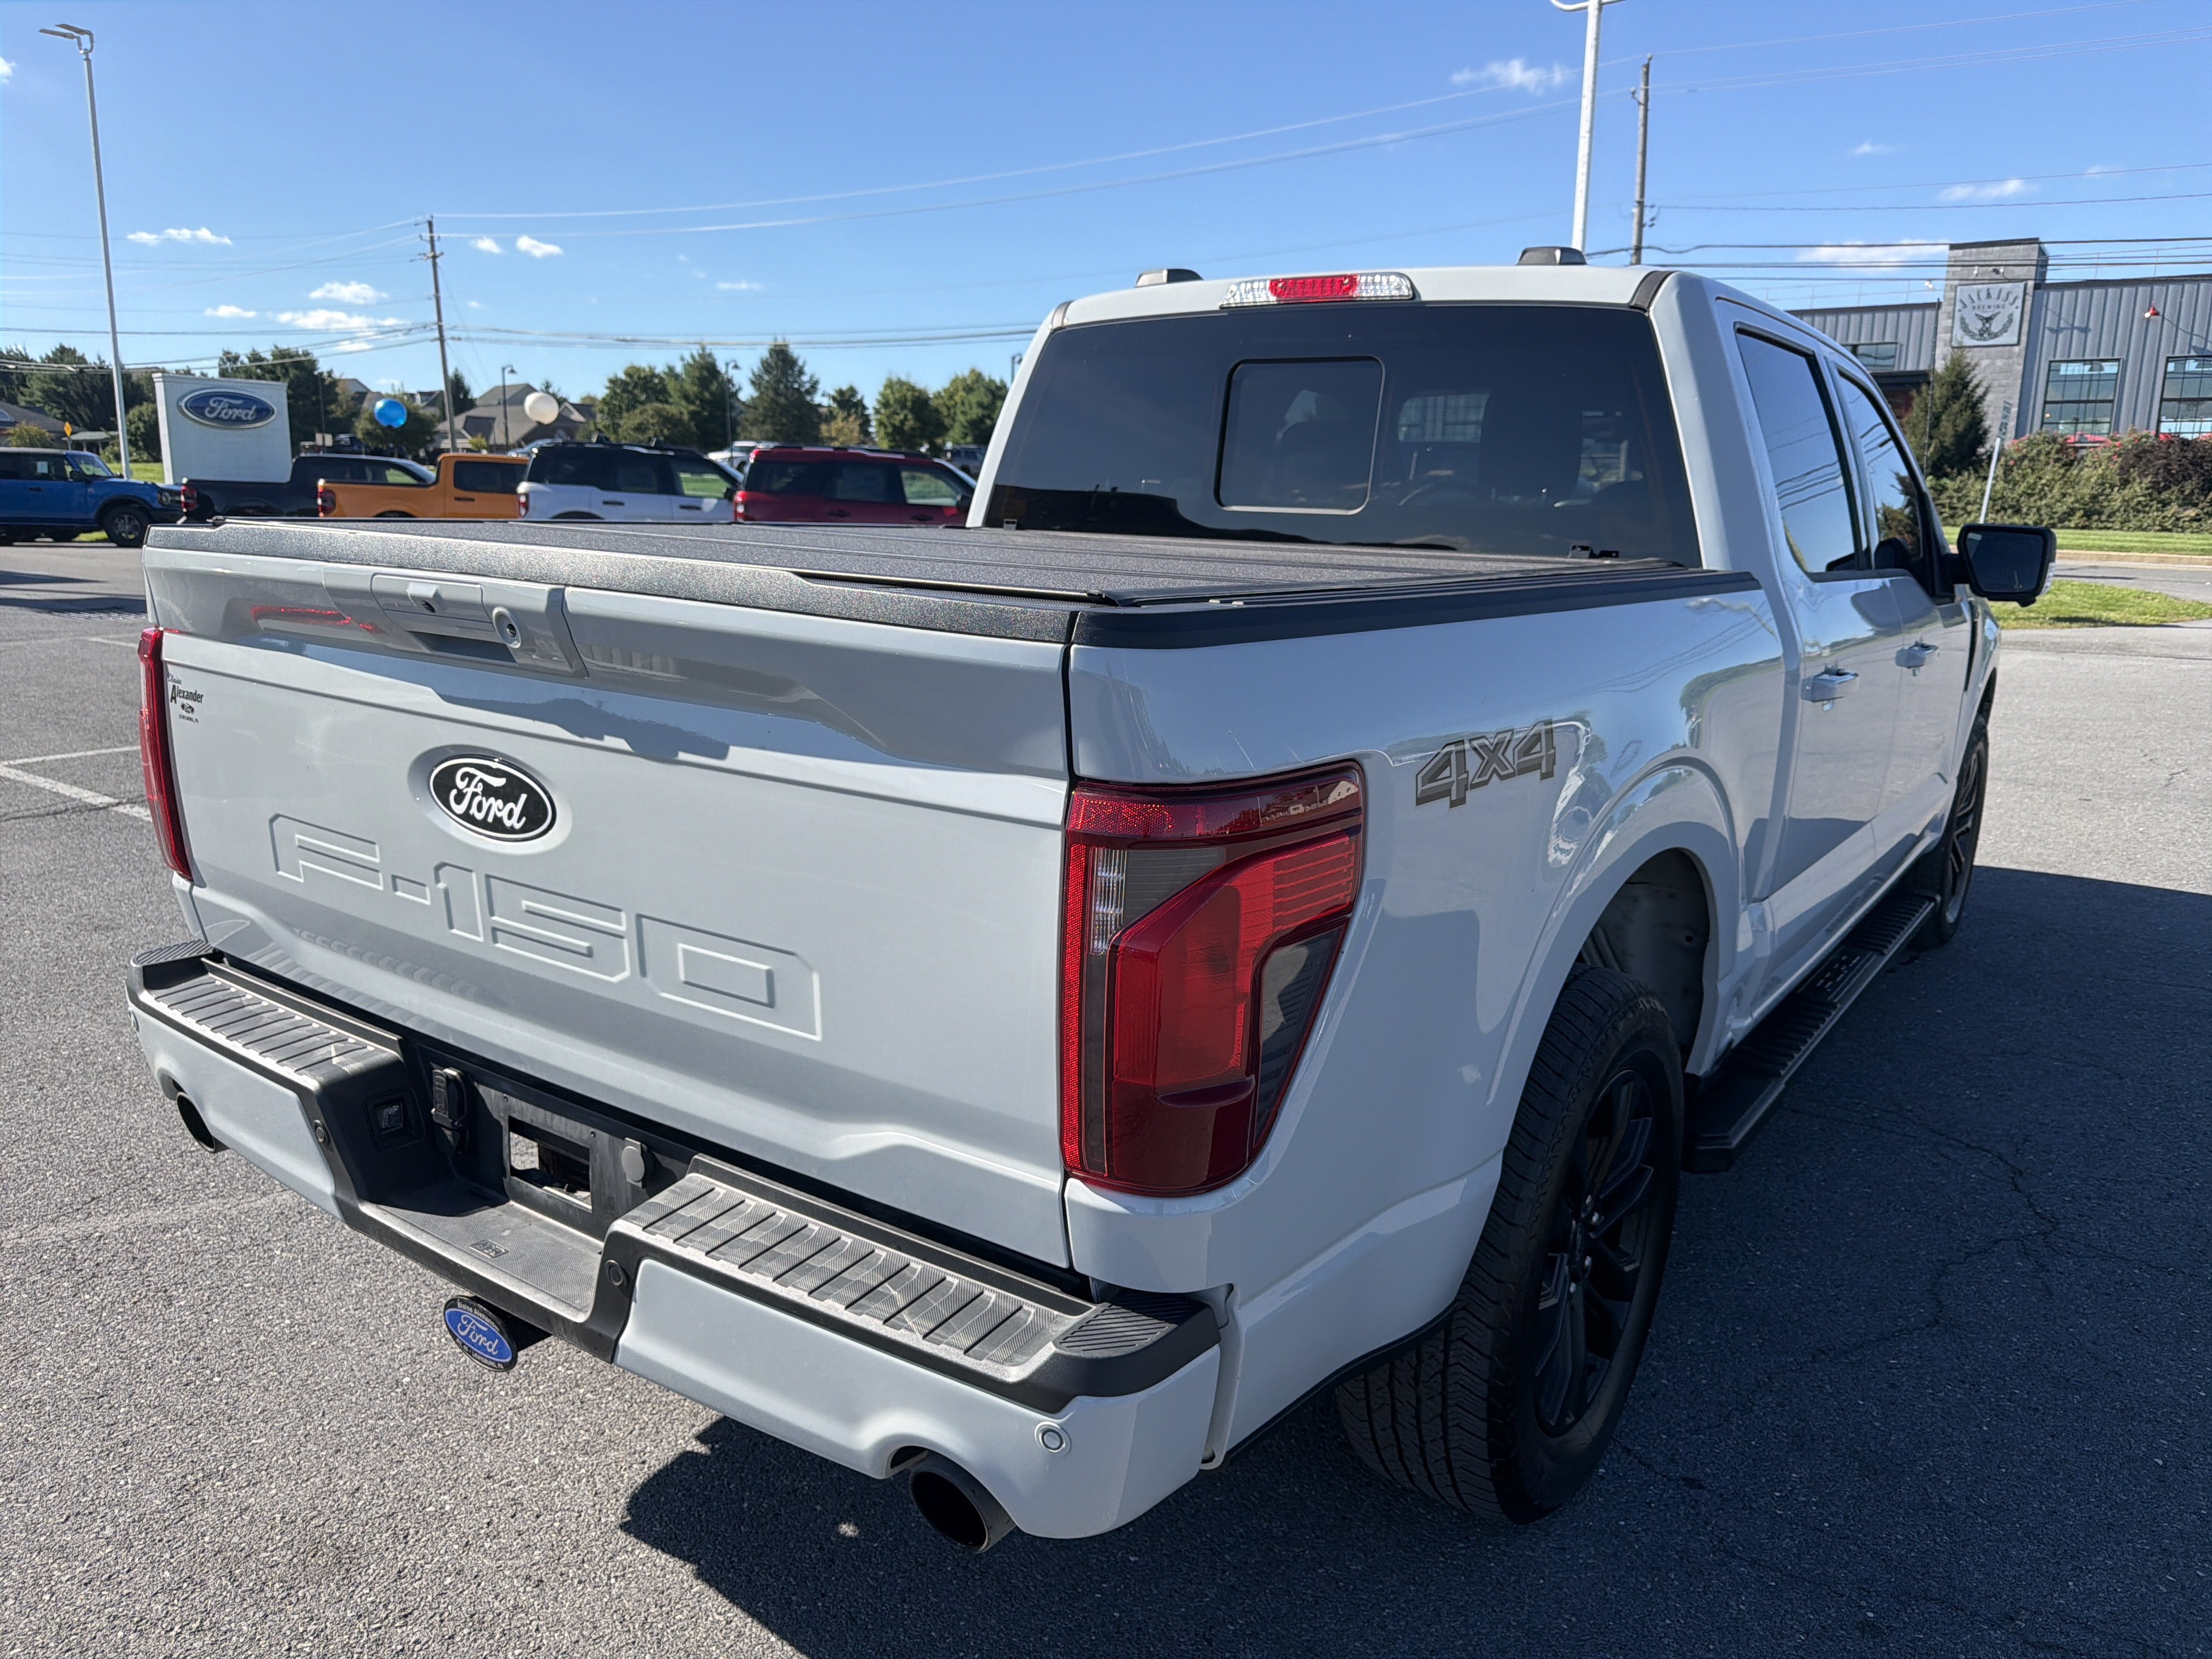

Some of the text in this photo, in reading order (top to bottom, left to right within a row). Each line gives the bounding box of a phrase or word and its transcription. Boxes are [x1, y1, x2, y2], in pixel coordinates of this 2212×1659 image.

[205, 397, 257, 421] Ford
[170, 684, 204, 704] Alexander
[449, 766, 527, 830] Ford
[268, 813, 822, 1041] F-150
[456, 1301, 500, 1332] Blaise Alexander
[457, 1314, 499, 1355] Ford
